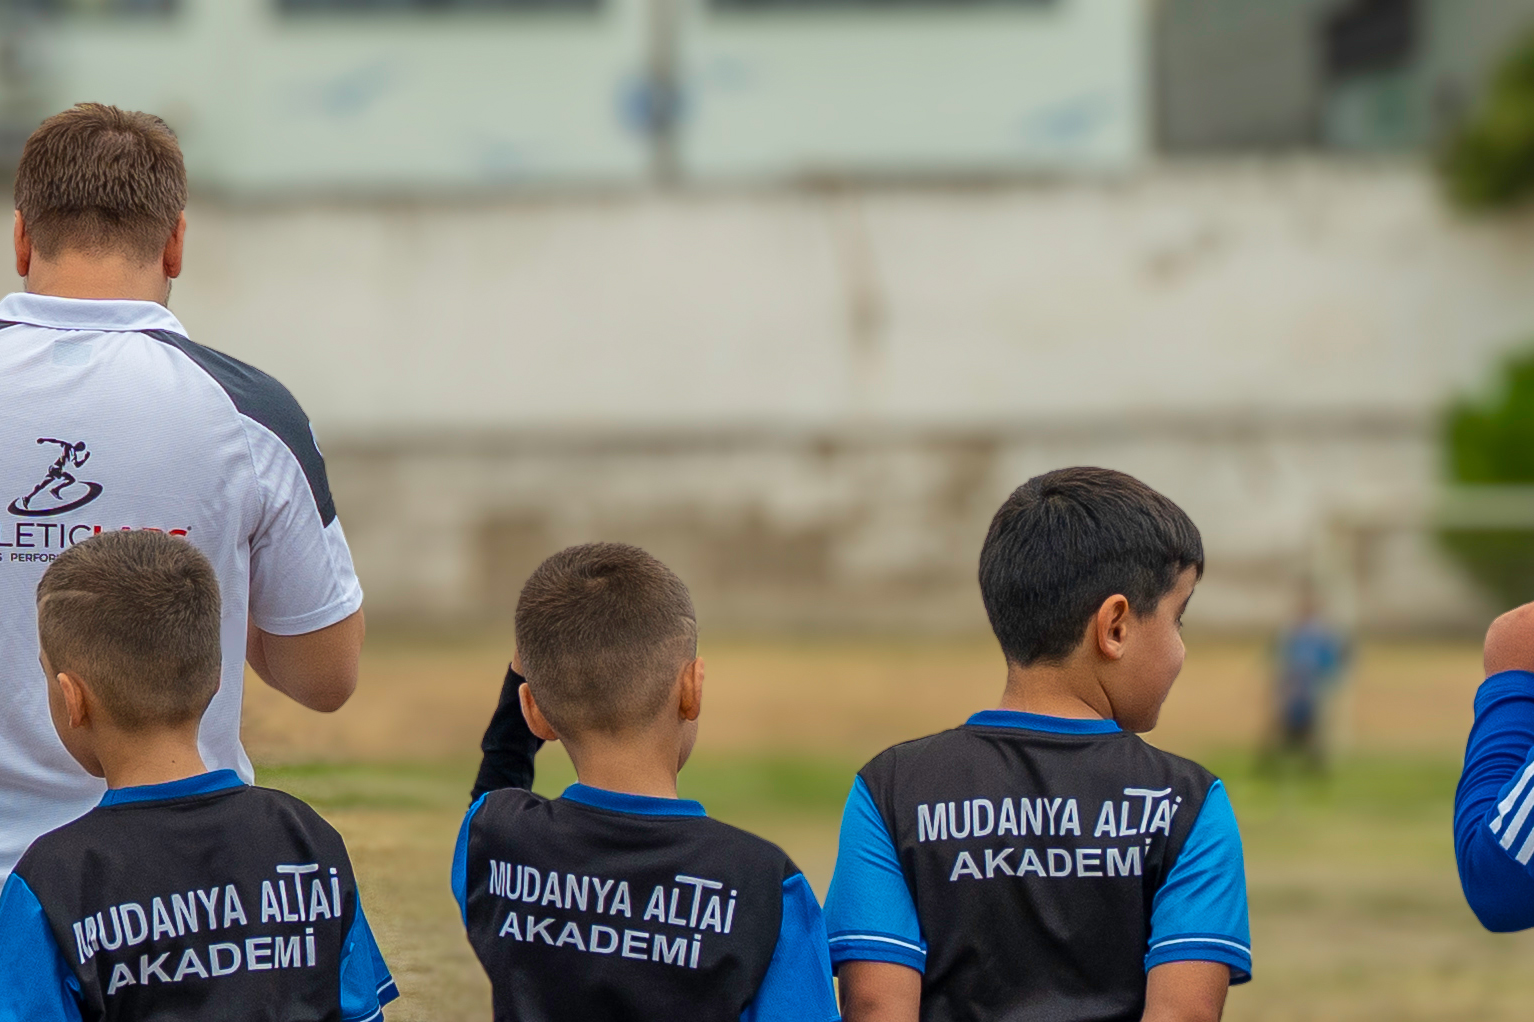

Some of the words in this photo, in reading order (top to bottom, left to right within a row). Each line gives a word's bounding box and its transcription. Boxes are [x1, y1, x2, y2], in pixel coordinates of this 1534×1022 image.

[10, 552, 58, 563] PERFOR
[917, 797, 1082, 843] MUDANYA
[72, 884, 248, 965] MUDANYA
[488, 859, 632, 918] MUDANYA
[643, 874, 739, 934] ALTAİ
[106, 927, 317, 996] AKADEMİ
[498, 911, 703, 970] AKADEMİ
